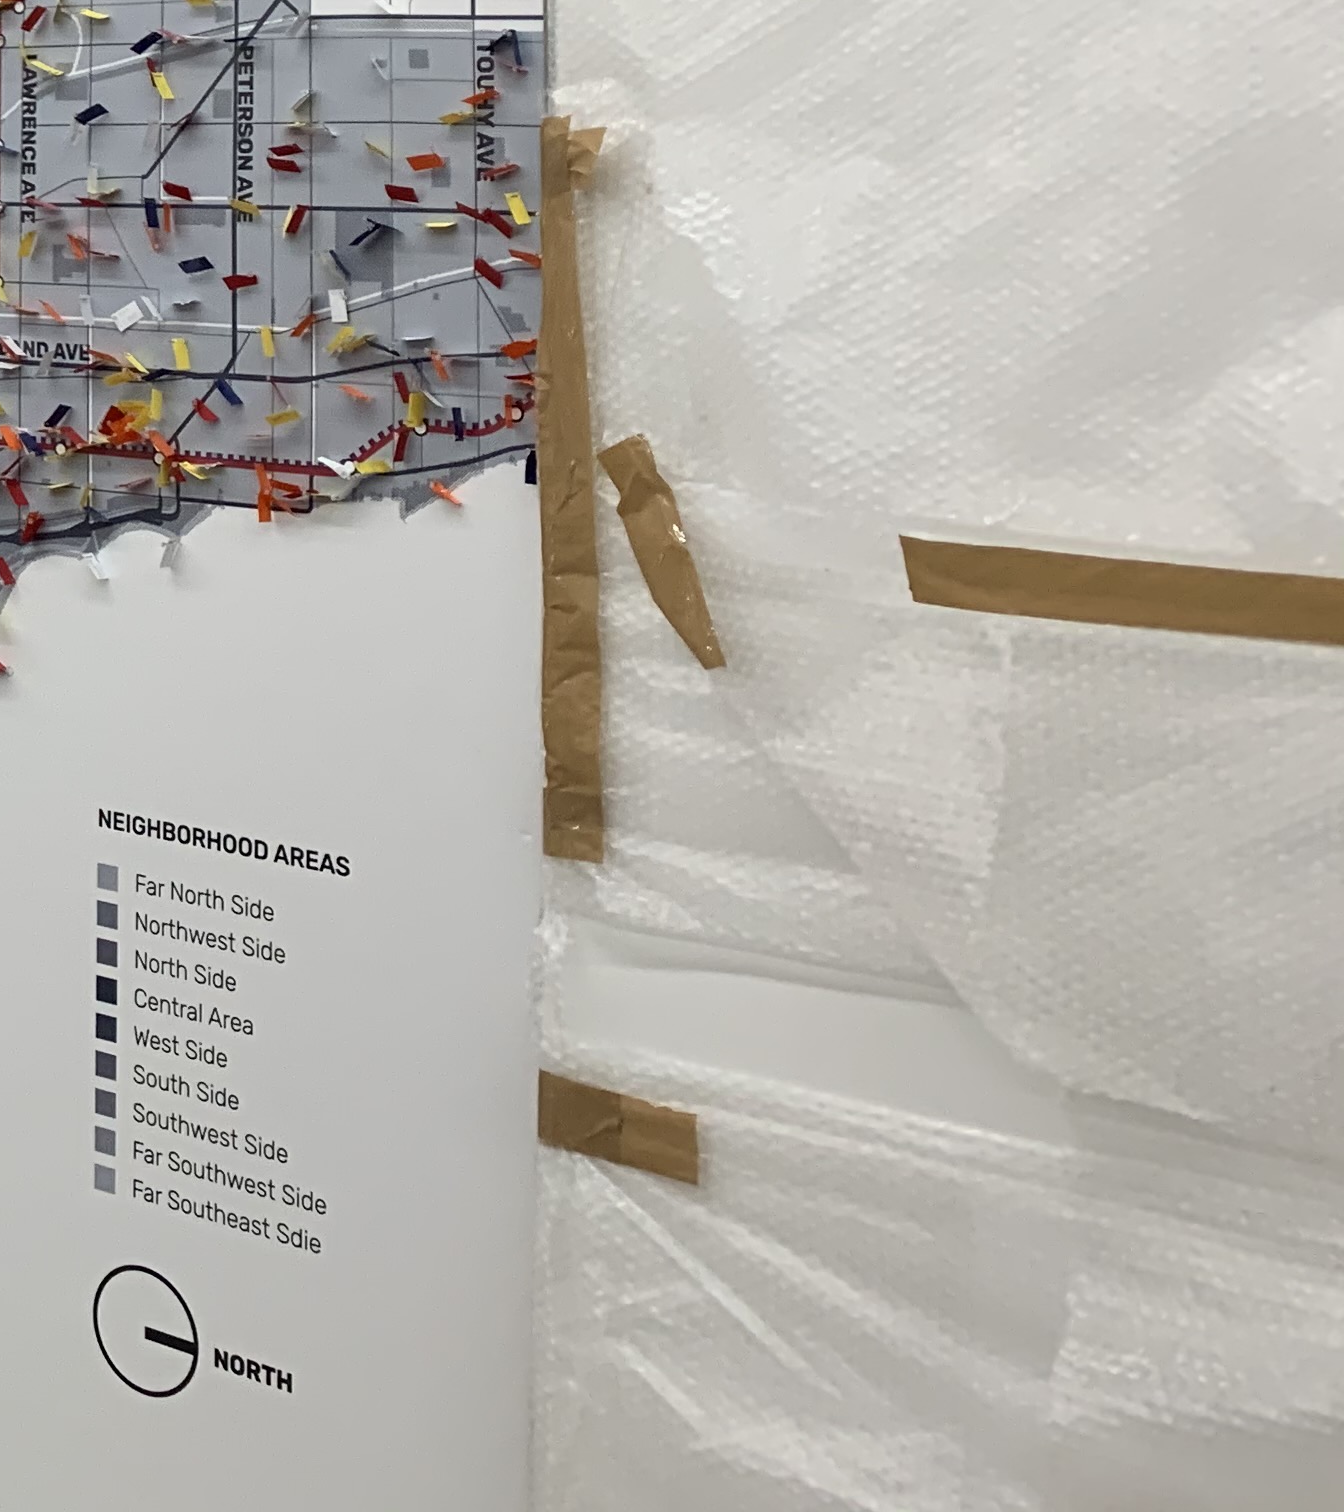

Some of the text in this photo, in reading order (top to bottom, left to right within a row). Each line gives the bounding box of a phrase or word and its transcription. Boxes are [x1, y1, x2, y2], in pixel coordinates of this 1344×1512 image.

[236, 44, 255, 223] PETERSON AVE
[53, 342, 91, 362] AVE
[98, 808, 351, 877] NEIGHBORHOOD AREAS
[135, 873, 275, 922] Far North Side
[134, 911, 286, 964] Northwest Side
[134, 949, 237, 992] North Side
[133, 988, 254, 1036] Central Area
[133, 1025, 228, 1068] West Side
[132, 1064, 240, 1111] South Side
[132, 1102, 289, 1164] Southwest Side
[132, 1140, 328, 1215] Far Southwest Side
[132, 1178, 322, 1254] Far Southeast Sdie
[213, 1347, 293, 1394] NORTH
